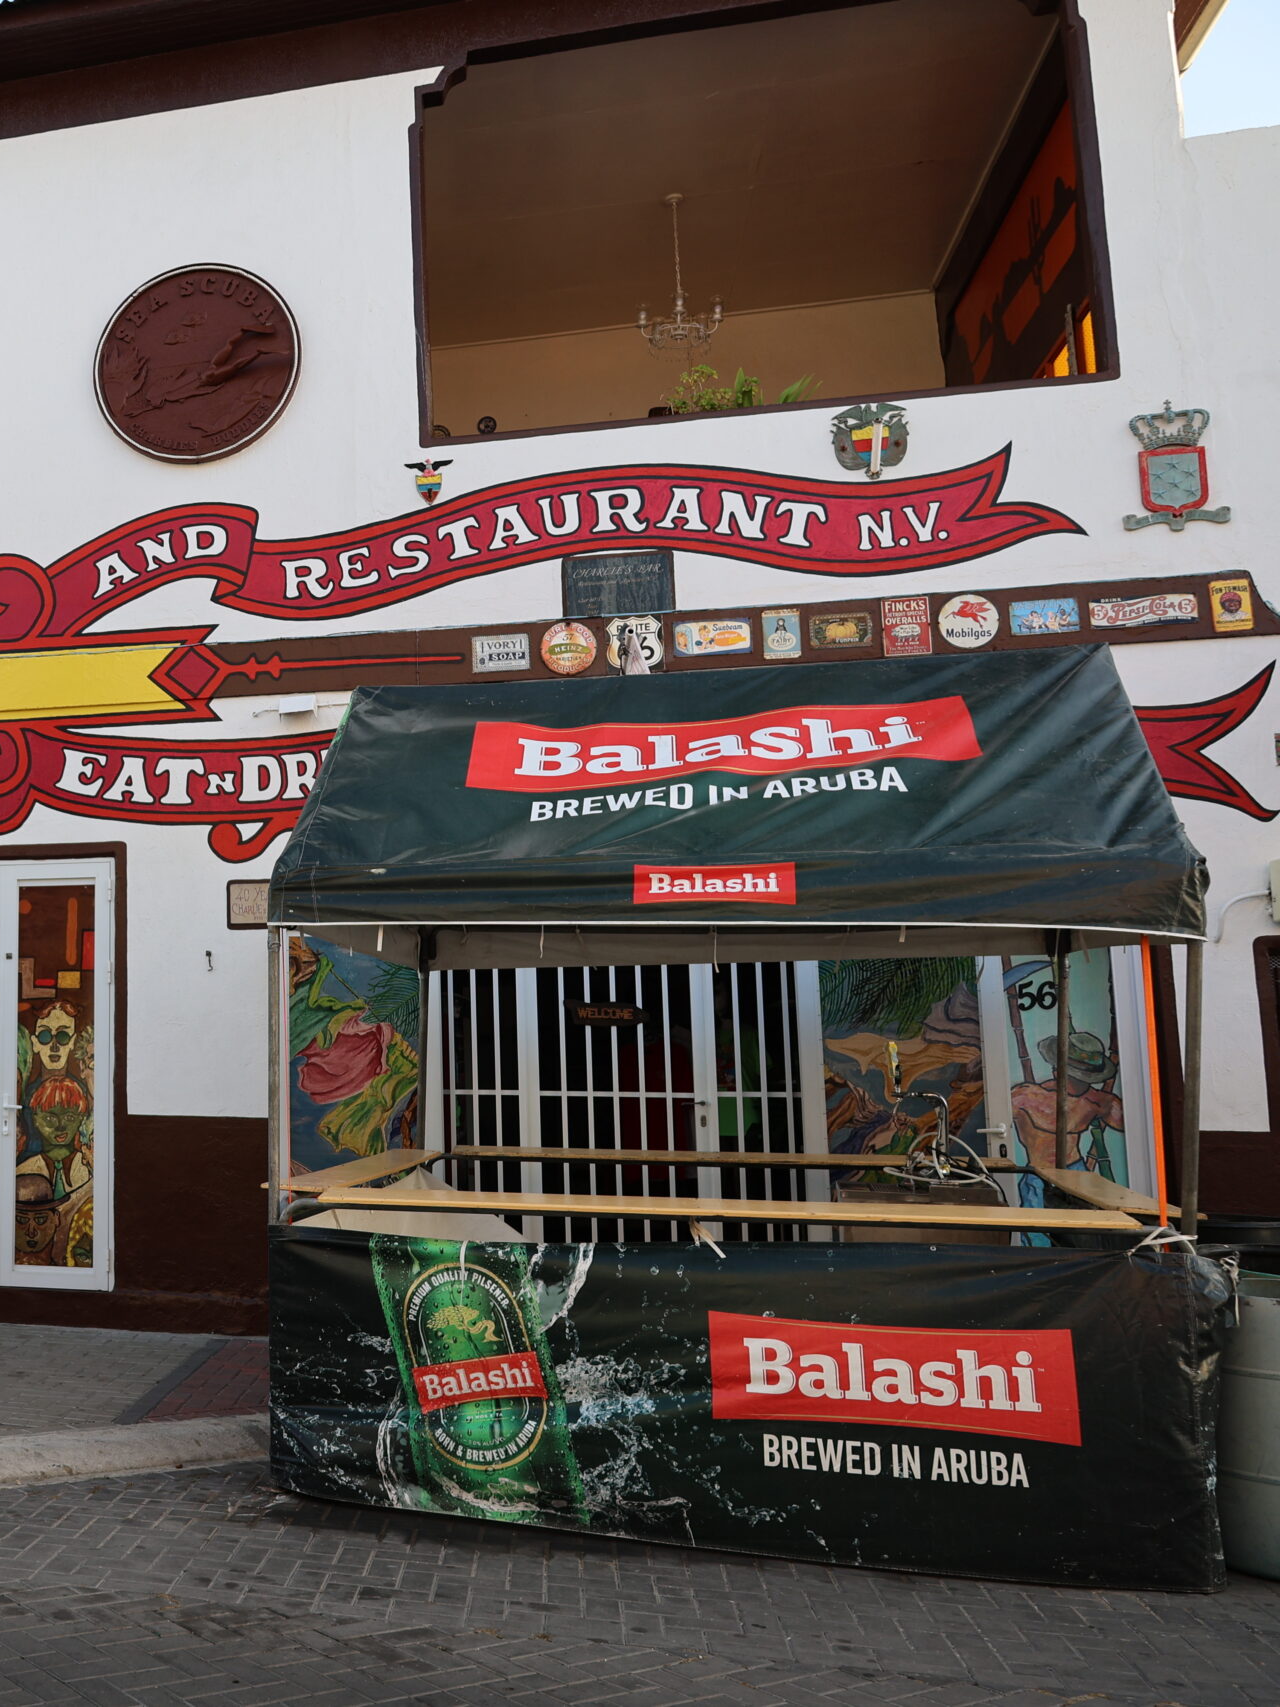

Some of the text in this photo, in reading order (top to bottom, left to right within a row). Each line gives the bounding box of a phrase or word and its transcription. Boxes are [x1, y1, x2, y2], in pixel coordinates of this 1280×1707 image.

[178, 277, 276, 325] SCUBA
[93, 484, 949, 600] AND RESTAURANT N.V.
[885, 600, 926, 613] FINCK'S
[885, 616, 927, 626] OVERALLS
[554, 644, 583, 653] HEINZ
[945, 628, 993, 641] Mobilgas
[491, 652, 523, 661] SOAP
[513, 716, 923, 779] Balashi
[56, 748, 206, 804] EAT
[530, 766, 909, 822] BREWED IN ARUBA
[648, 871, 781, 896] Balashi
[577, 1007, 634, 1020] WELCOME
[1018, 980, 1058, 1011] 56
[408, 1270, 510, 1322] PREMIUM QUALITY PILSENER
[421, 1360, 536, 1400] Balashi
[743, 1337, 1042, 1413] Balashi
[435, 1420, 538, 1462] BORN & BREWED IN ARUBA
[763, 1433, 1030, 1489] BREWED IN ARUBA
